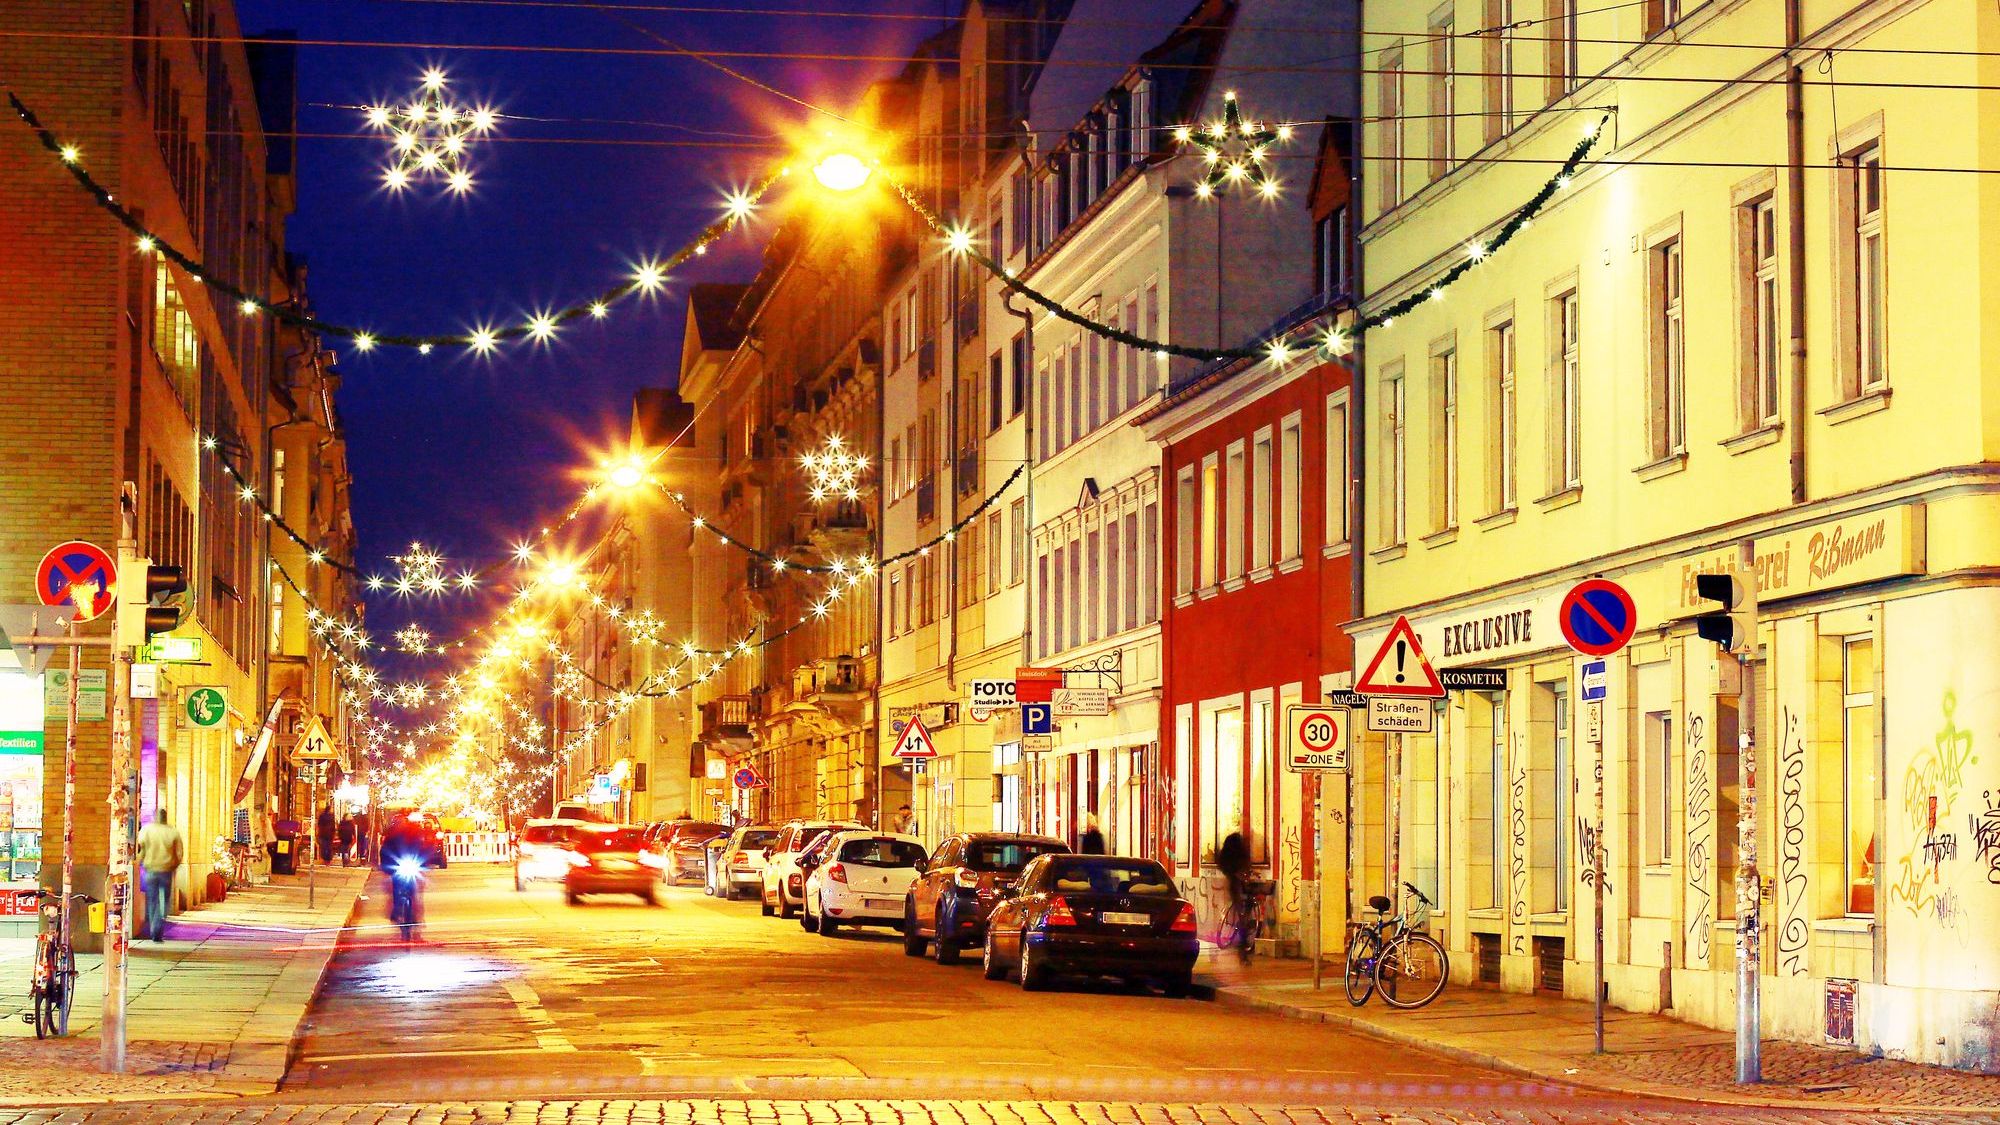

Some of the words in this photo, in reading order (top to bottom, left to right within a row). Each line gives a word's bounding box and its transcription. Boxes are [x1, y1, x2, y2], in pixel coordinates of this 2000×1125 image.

[1808, 518, 1885, 587] Rißmann
[1443, 608, 1532, 657] EXCLUSIVE
[1443, 673, 1504, 685] KOSMETIK
[974, 682, 1017, 696] FOTO
[1376, 702, 1424, 714] Straßen-
[1028, 707, 1045, 731] P
[1377, 716, 1422, 727] schäden
[1307, 724, 1330, 742] 30
[1304, 755, 1333, 765] ZONE
